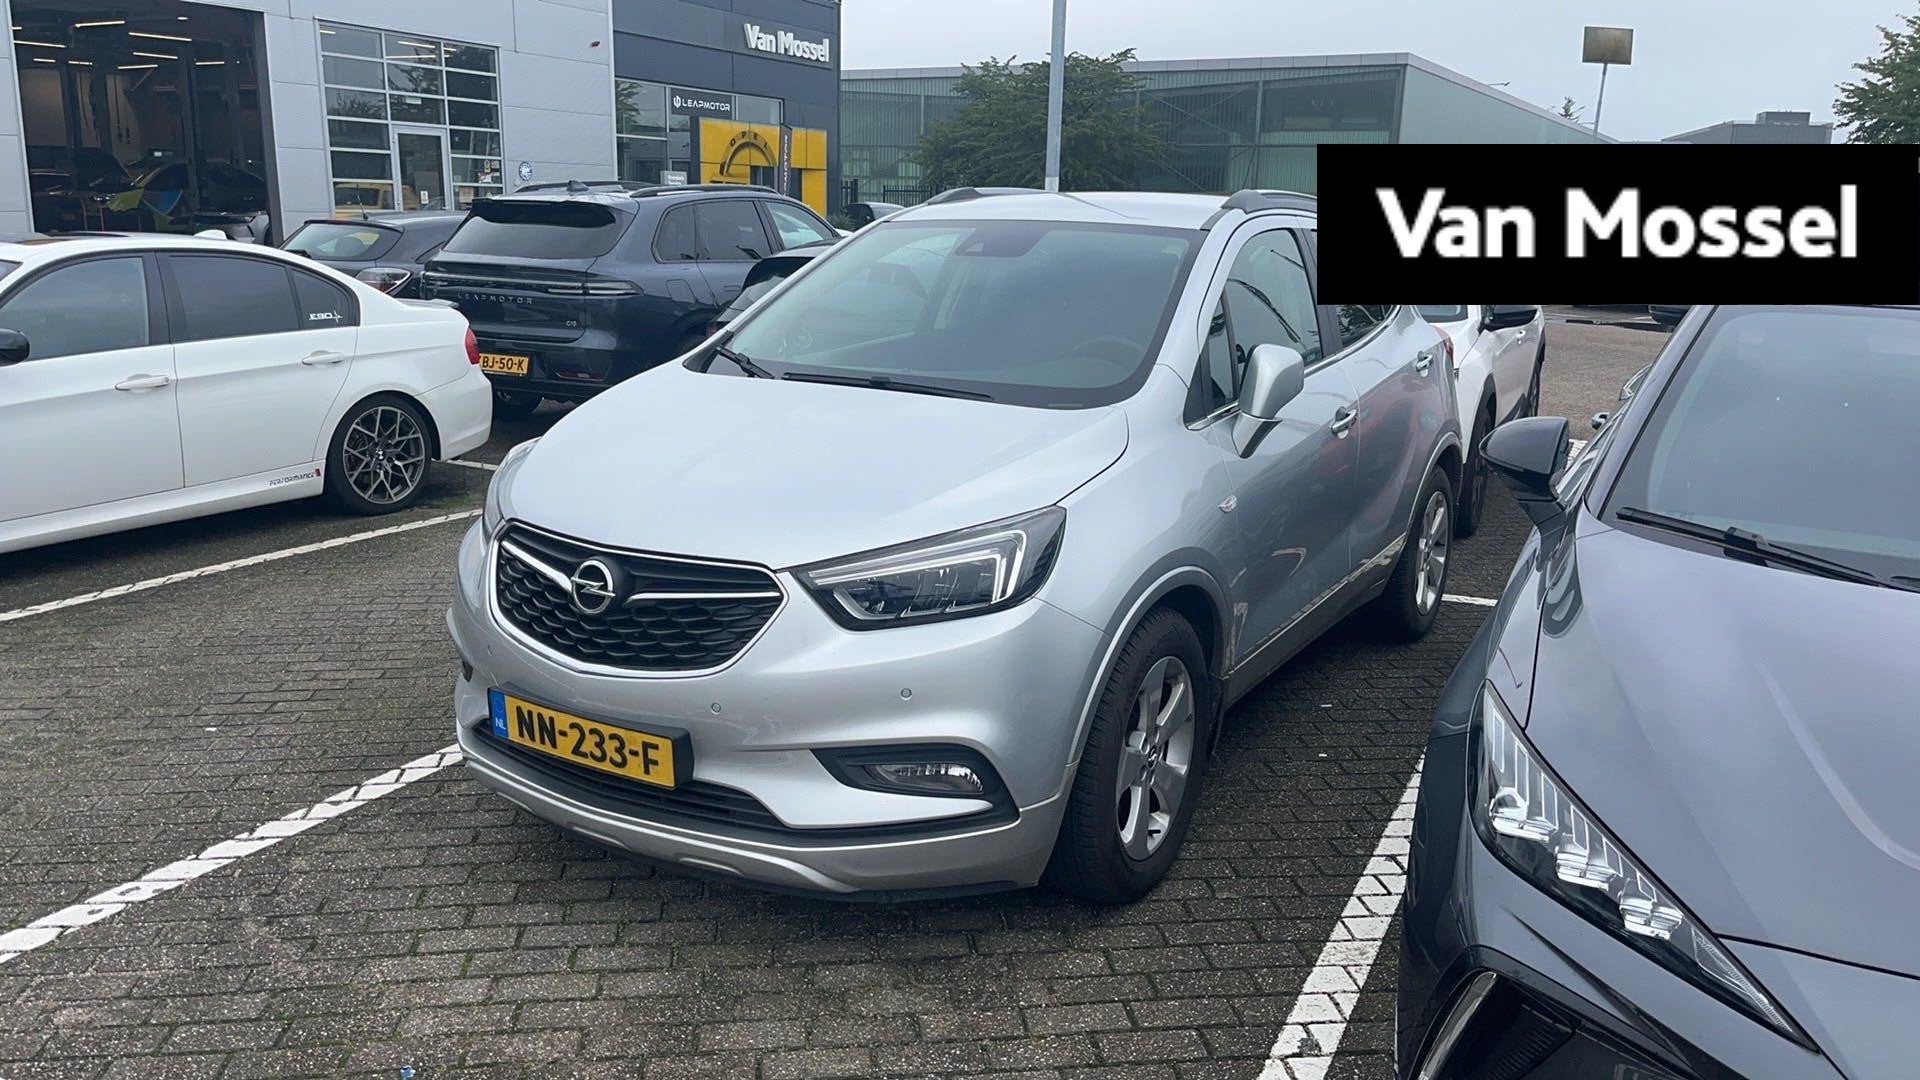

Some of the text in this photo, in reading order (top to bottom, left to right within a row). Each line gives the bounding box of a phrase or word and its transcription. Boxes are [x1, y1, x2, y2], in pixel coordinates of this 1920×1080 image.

[744, 23, 829, 62] Van Mossel
[682, 98, 730, 111] LEAPMOTOR
[730, 131, 768, 150] OPEL
[479, 355, 525, 372] BJ-50-K
[495, 717, 506, 730] NL
[516, 705, 659, 776] NN-233-F
